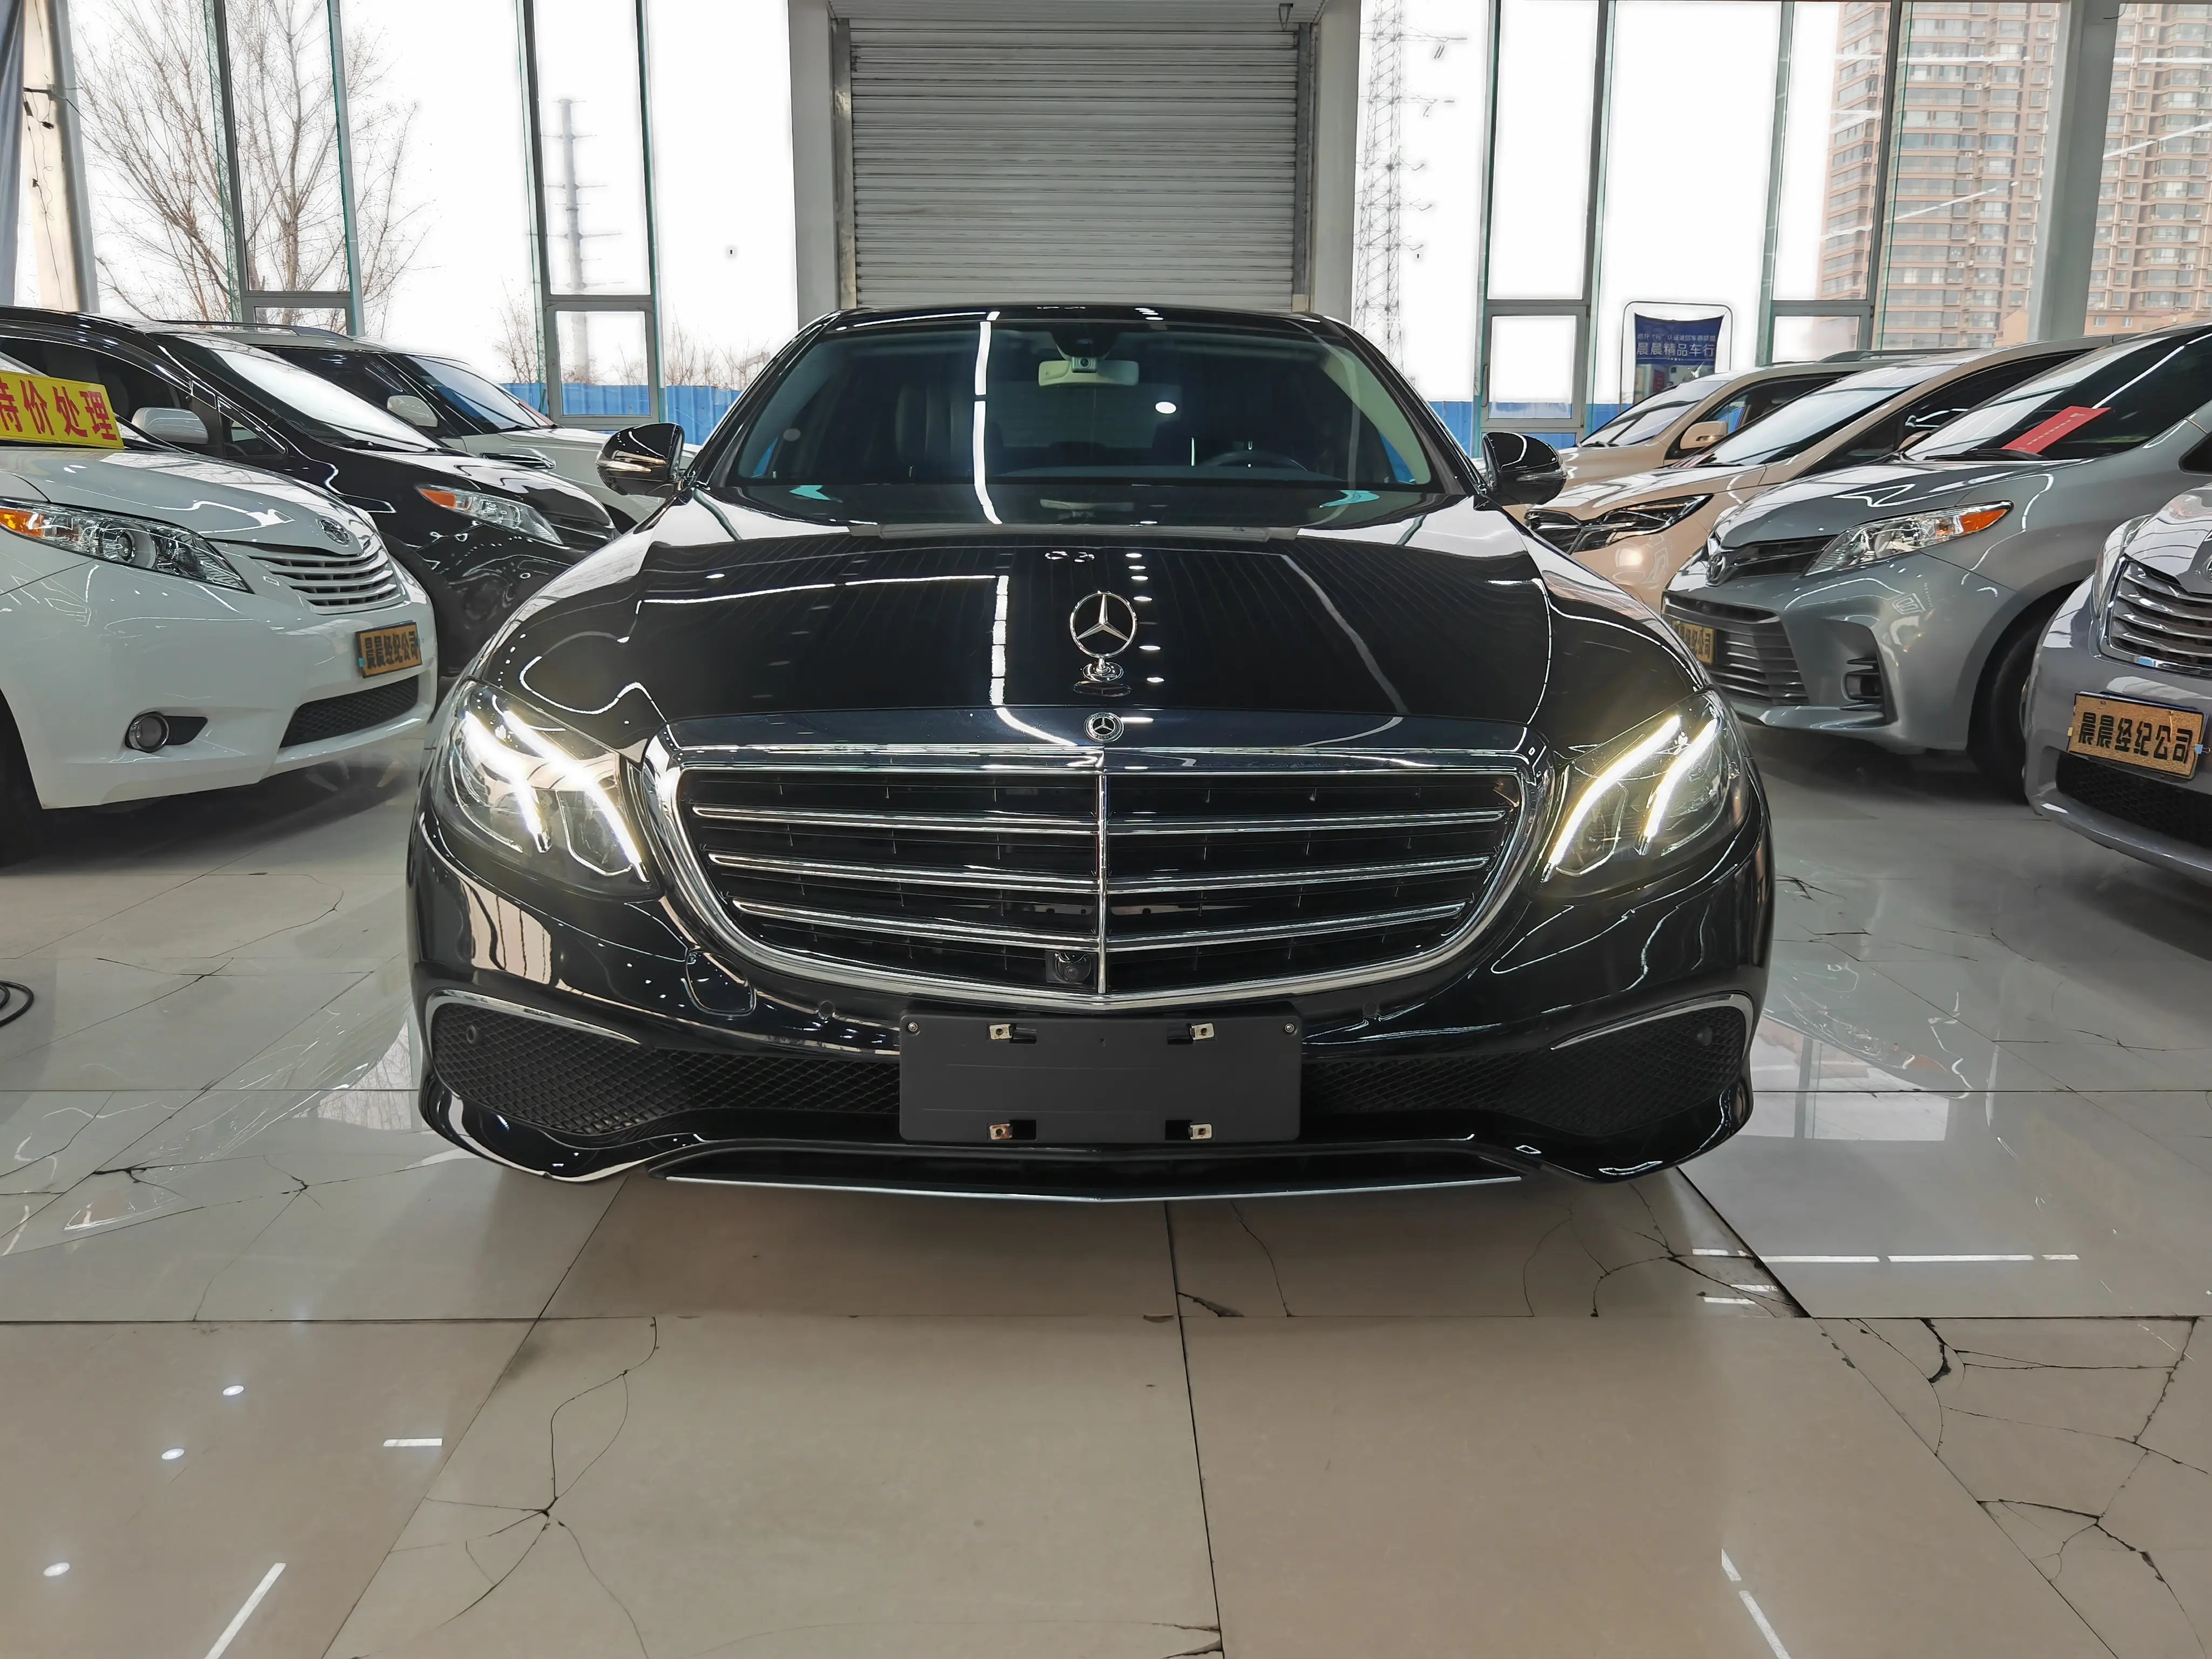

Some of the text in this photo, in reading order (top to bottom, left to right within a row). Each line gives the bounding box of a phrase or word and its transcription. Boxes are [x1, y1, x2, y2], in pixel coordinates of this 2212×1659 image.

[1636, 342, 1715, 357] 晨晨精品车行
[365, 631, 419, 670] 晨晨经纪公司
[2079, 711, 2193, 764] 晨晨经纪公司
